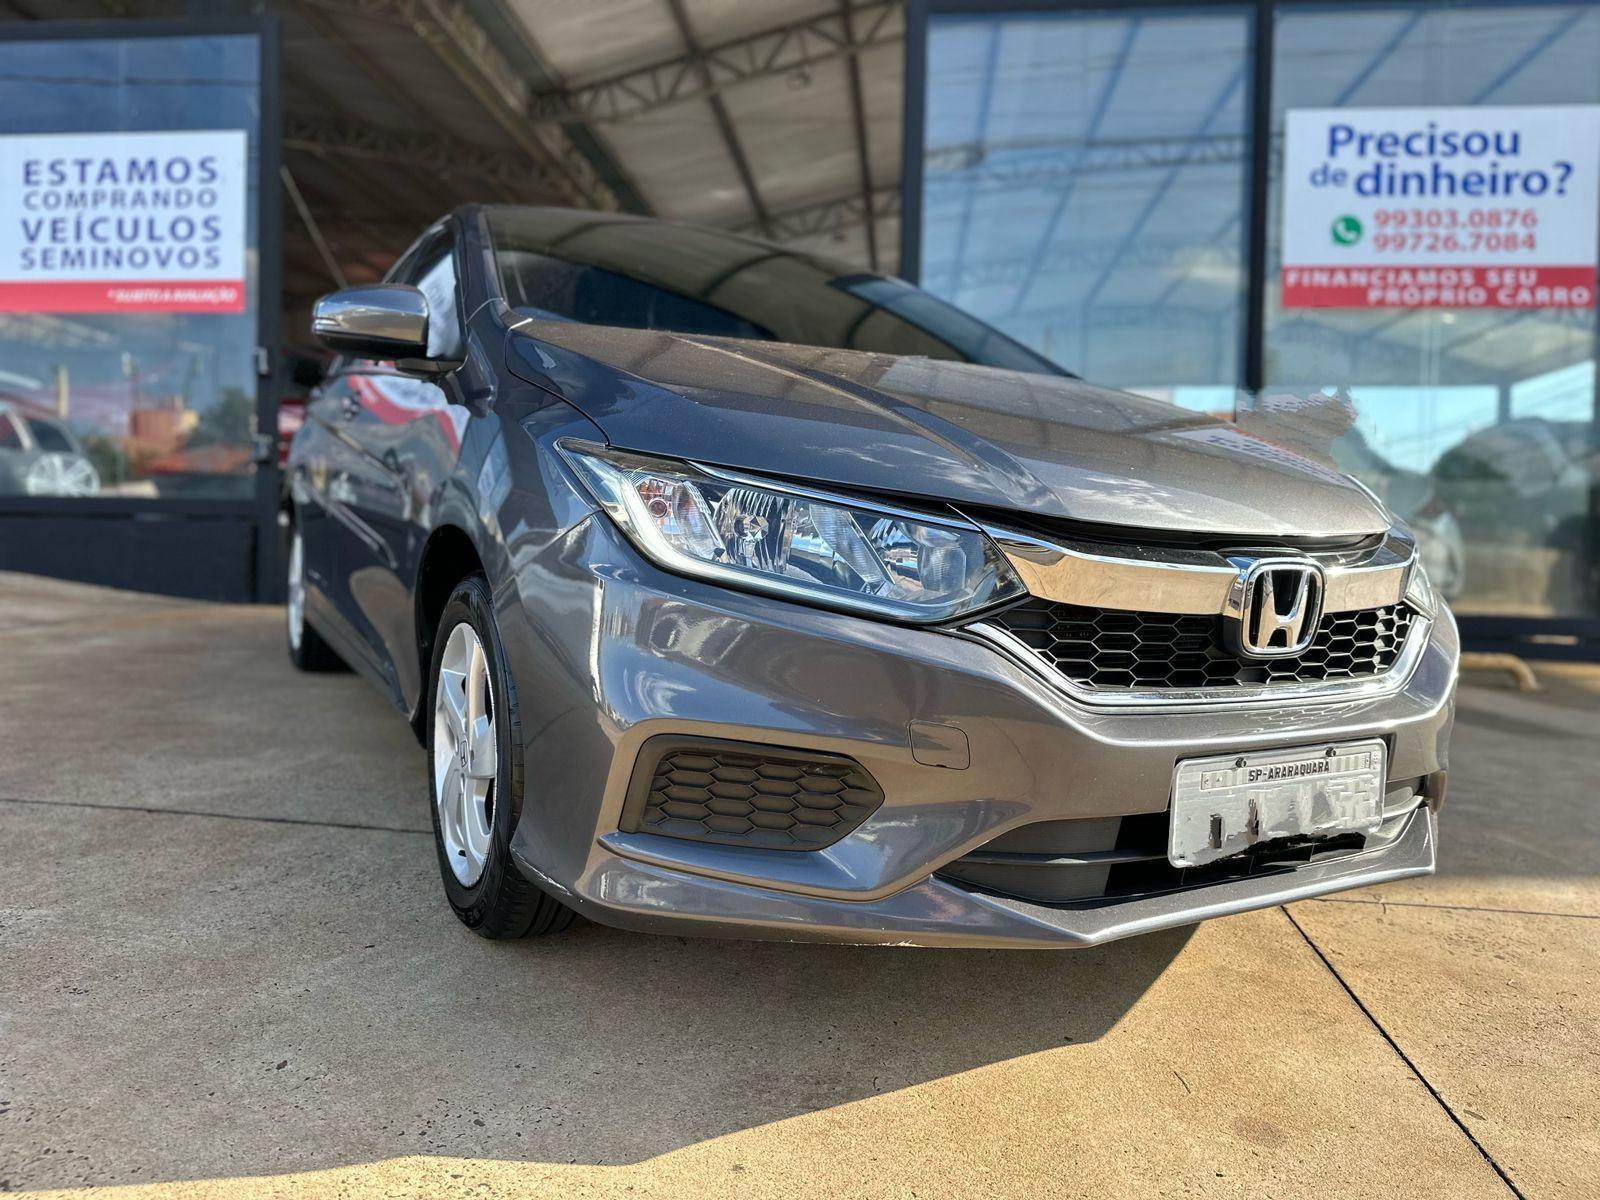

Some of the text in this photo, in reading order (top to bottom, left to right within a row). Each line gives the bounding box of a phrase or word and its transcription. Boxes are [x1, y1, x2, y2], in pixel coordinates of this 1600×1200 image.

[1328, 122, 1519, 157] Precisou
[23, 157, 218, 186] ESTAMOS
[1309, 161, 1573, 197] de dinheiro?
[23, 188, 218, 210] COMPRANDO
[21, 211, 221, 243] VEÍCULOS
[1374, 208, 1538, 229] 99303.0876
[1373, 231, 1536, 252] 99726.7084
[20, 246, 221, 270] SEMINOVOS
[1286, 269, 1538, 287] FINANCIAMOS SEU
[1497, 287, 1591, 304] CARRO
[1248, 761, 1330, 782] SP-ARARAQUARA
